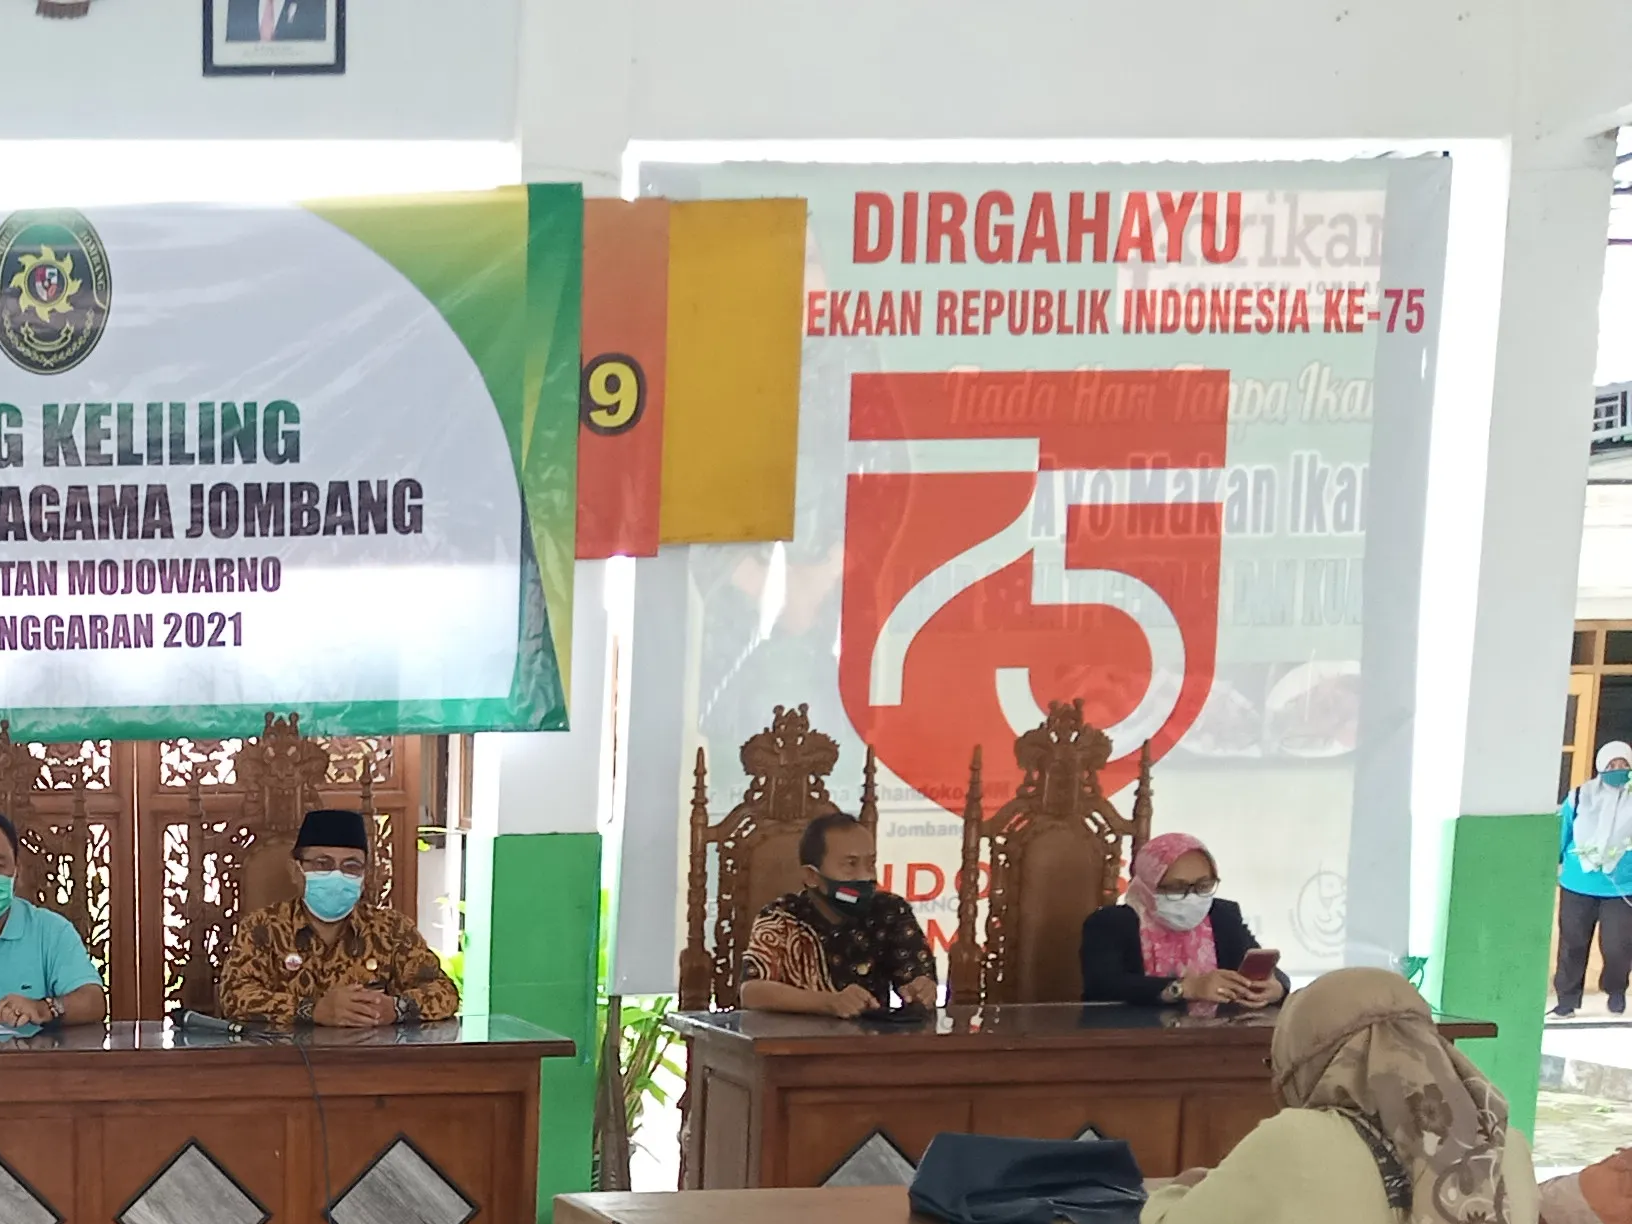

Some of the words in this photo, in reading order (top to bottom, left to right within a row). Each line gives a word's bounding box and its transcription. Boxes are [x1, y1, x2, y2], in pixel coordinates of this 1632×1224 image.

[853, 190, 1241, 264] DIRGAHAYU
[807, 289, 921, 336] EKAAN
[936, 289, 1111, 336] REPUBLIK
[1122, 289, 1310, 334] INDONESIA
[1323, 288, 1424, 334] KE-75
[42, 400, 301, 467] KELILING
[185, 477, 424, 540] JOMBANG
[1126, 449, 1277, 540] Makan
[67, 555, 282, 597] MOJOWARNO
[163, 611, 243, 649] 2021
